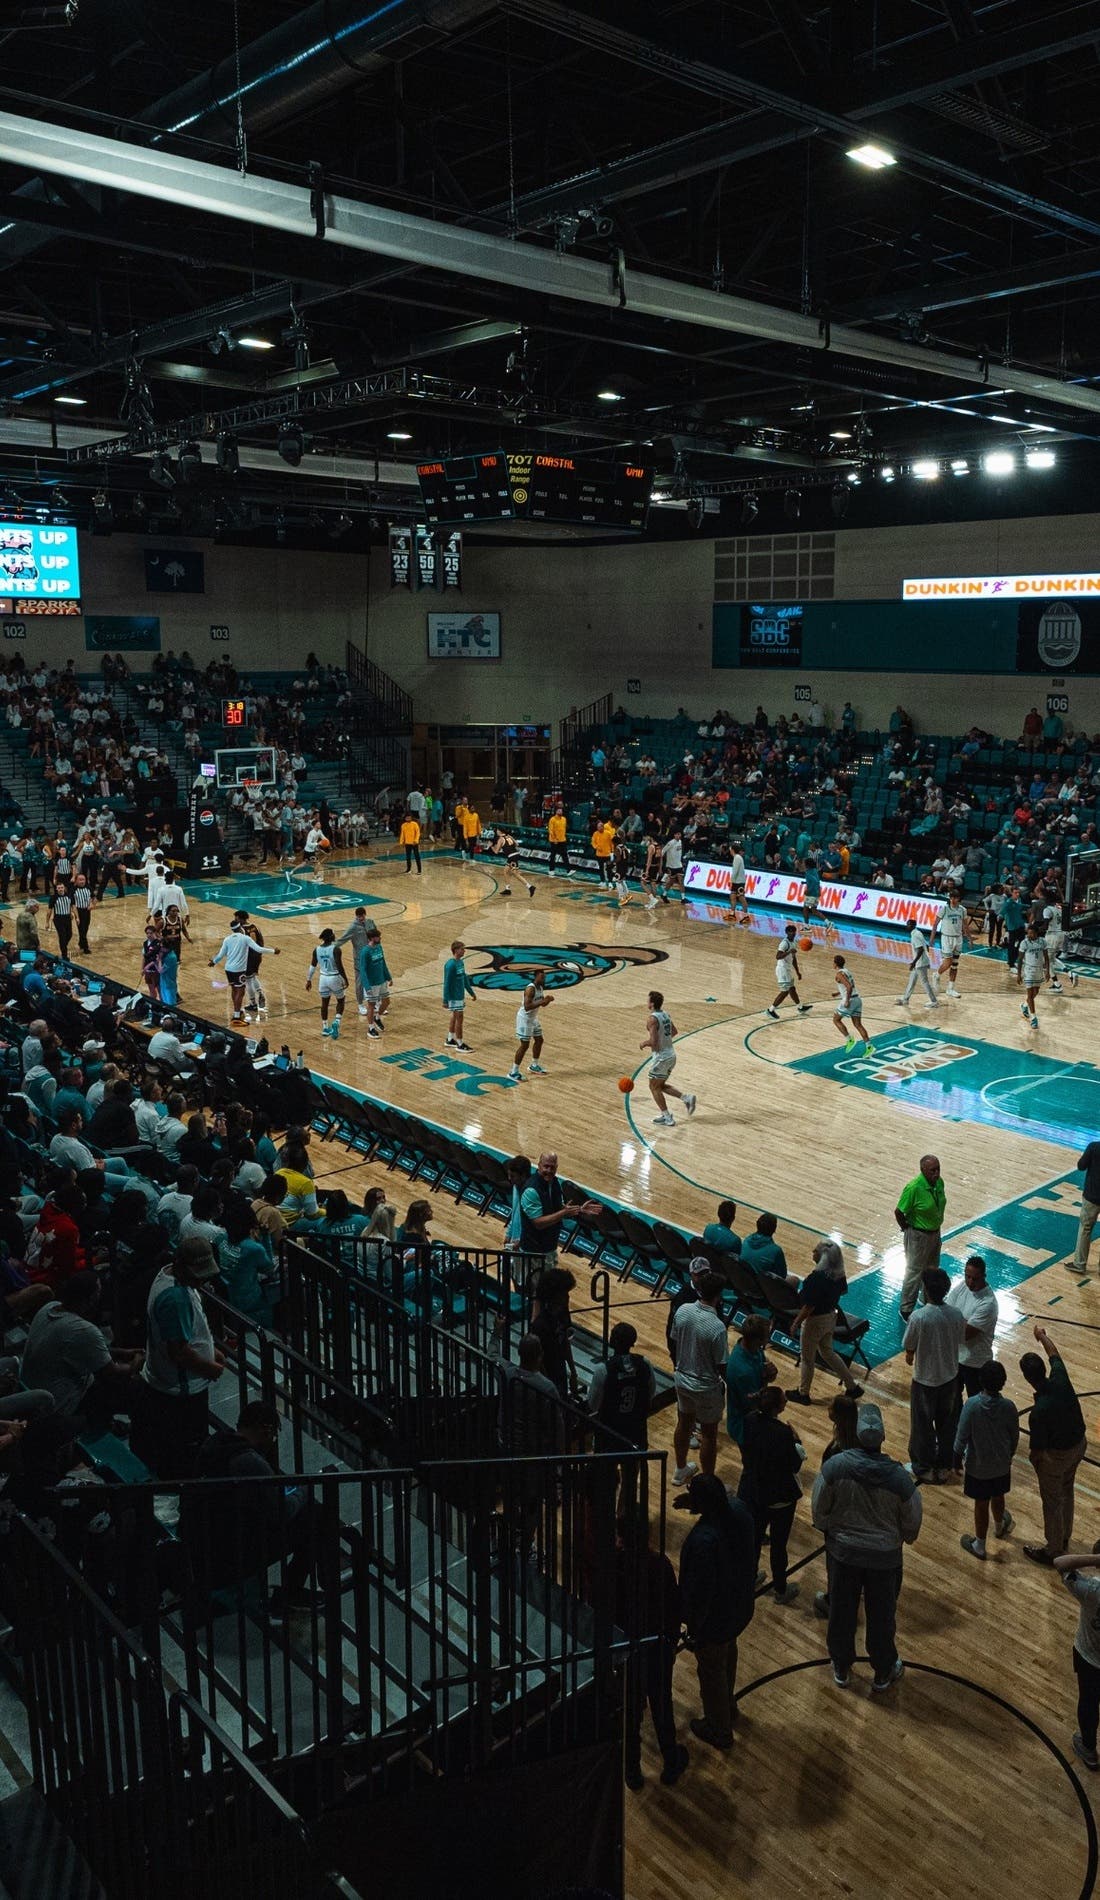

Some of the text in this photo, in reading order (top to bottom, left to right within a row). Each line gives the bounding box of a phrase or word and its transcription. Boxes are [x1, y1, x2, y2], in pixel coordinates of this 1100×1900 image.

[506, 454, 533, 465] 707
[536, 455, 575, 470] COASTAL
[417, 463, 445, 475] COASTAL
[509, 466, 531, 474] Indoor
[510, 476, 531, 485] Range
[39, 531, 68, 545] UP
[40, 555, 70, 569] UP
[393, 554, 408, 569] 23
[419, 555, 434, 570] 50
[444, 557, 459, 572] 25
[42, 579, 71, 593] UP
[905, 581, 989, 595] DUNKIN'
[17, 600, 78, 608] SPARKS
[19, 607, 79, 615] TOYOTA
[4, 625, 25, 637] 102
[211, 628, 229, 639] 103
[437, 629, 491, 647] HTC
[750, 619, 790, 646] SBC
[628, 682, 640, 692] 104
[795, 689, 810, 700] 105
[228, 702, 244, 710] 3:18
[1047, 697, 1067, 711] 106
[227, 710, 242, 724] 30
[833, 1037, 979, 1083] SBC
[378, 1047, 520, 1097] HTC
[780, 1336, 792, 1346] CAT
[620, 1386, 636, 1413] 3
